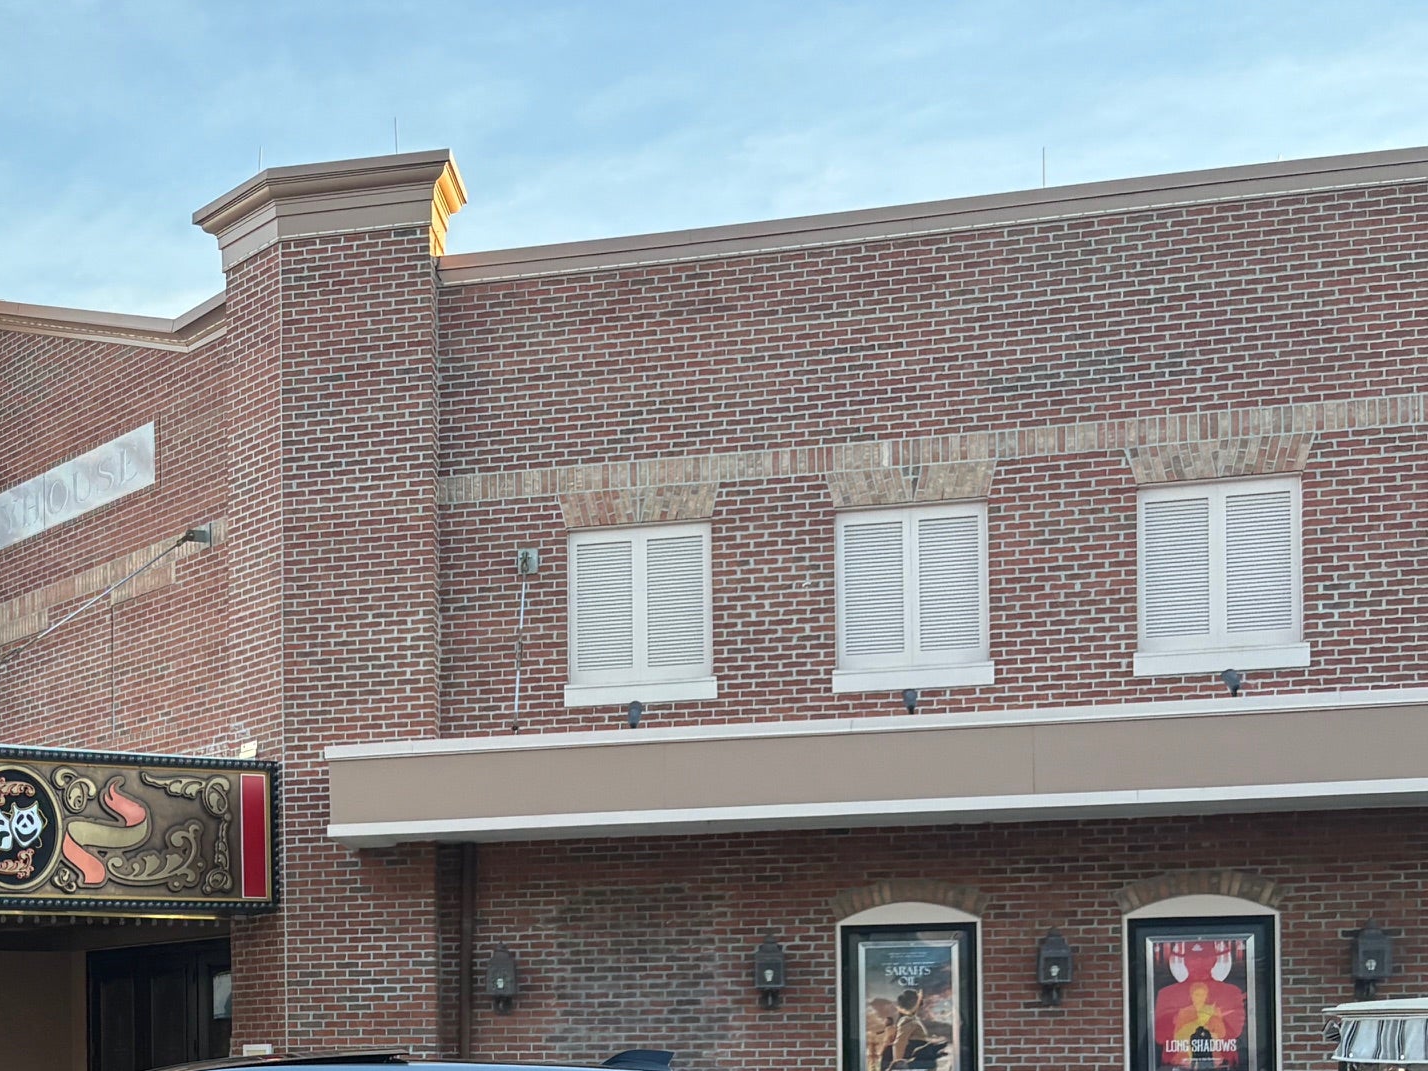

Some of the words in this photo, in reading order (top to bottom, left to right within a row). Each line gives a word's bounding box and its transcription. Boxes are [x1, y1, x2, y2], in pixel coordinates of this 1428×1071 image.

[885, 966, 931, 976] SARAH'S
[898, 976, 918, 986] OIL
[1166, 1040, 1189, 1052] LONG
[1192, 1039, 1237, 1052] SHADOWS
